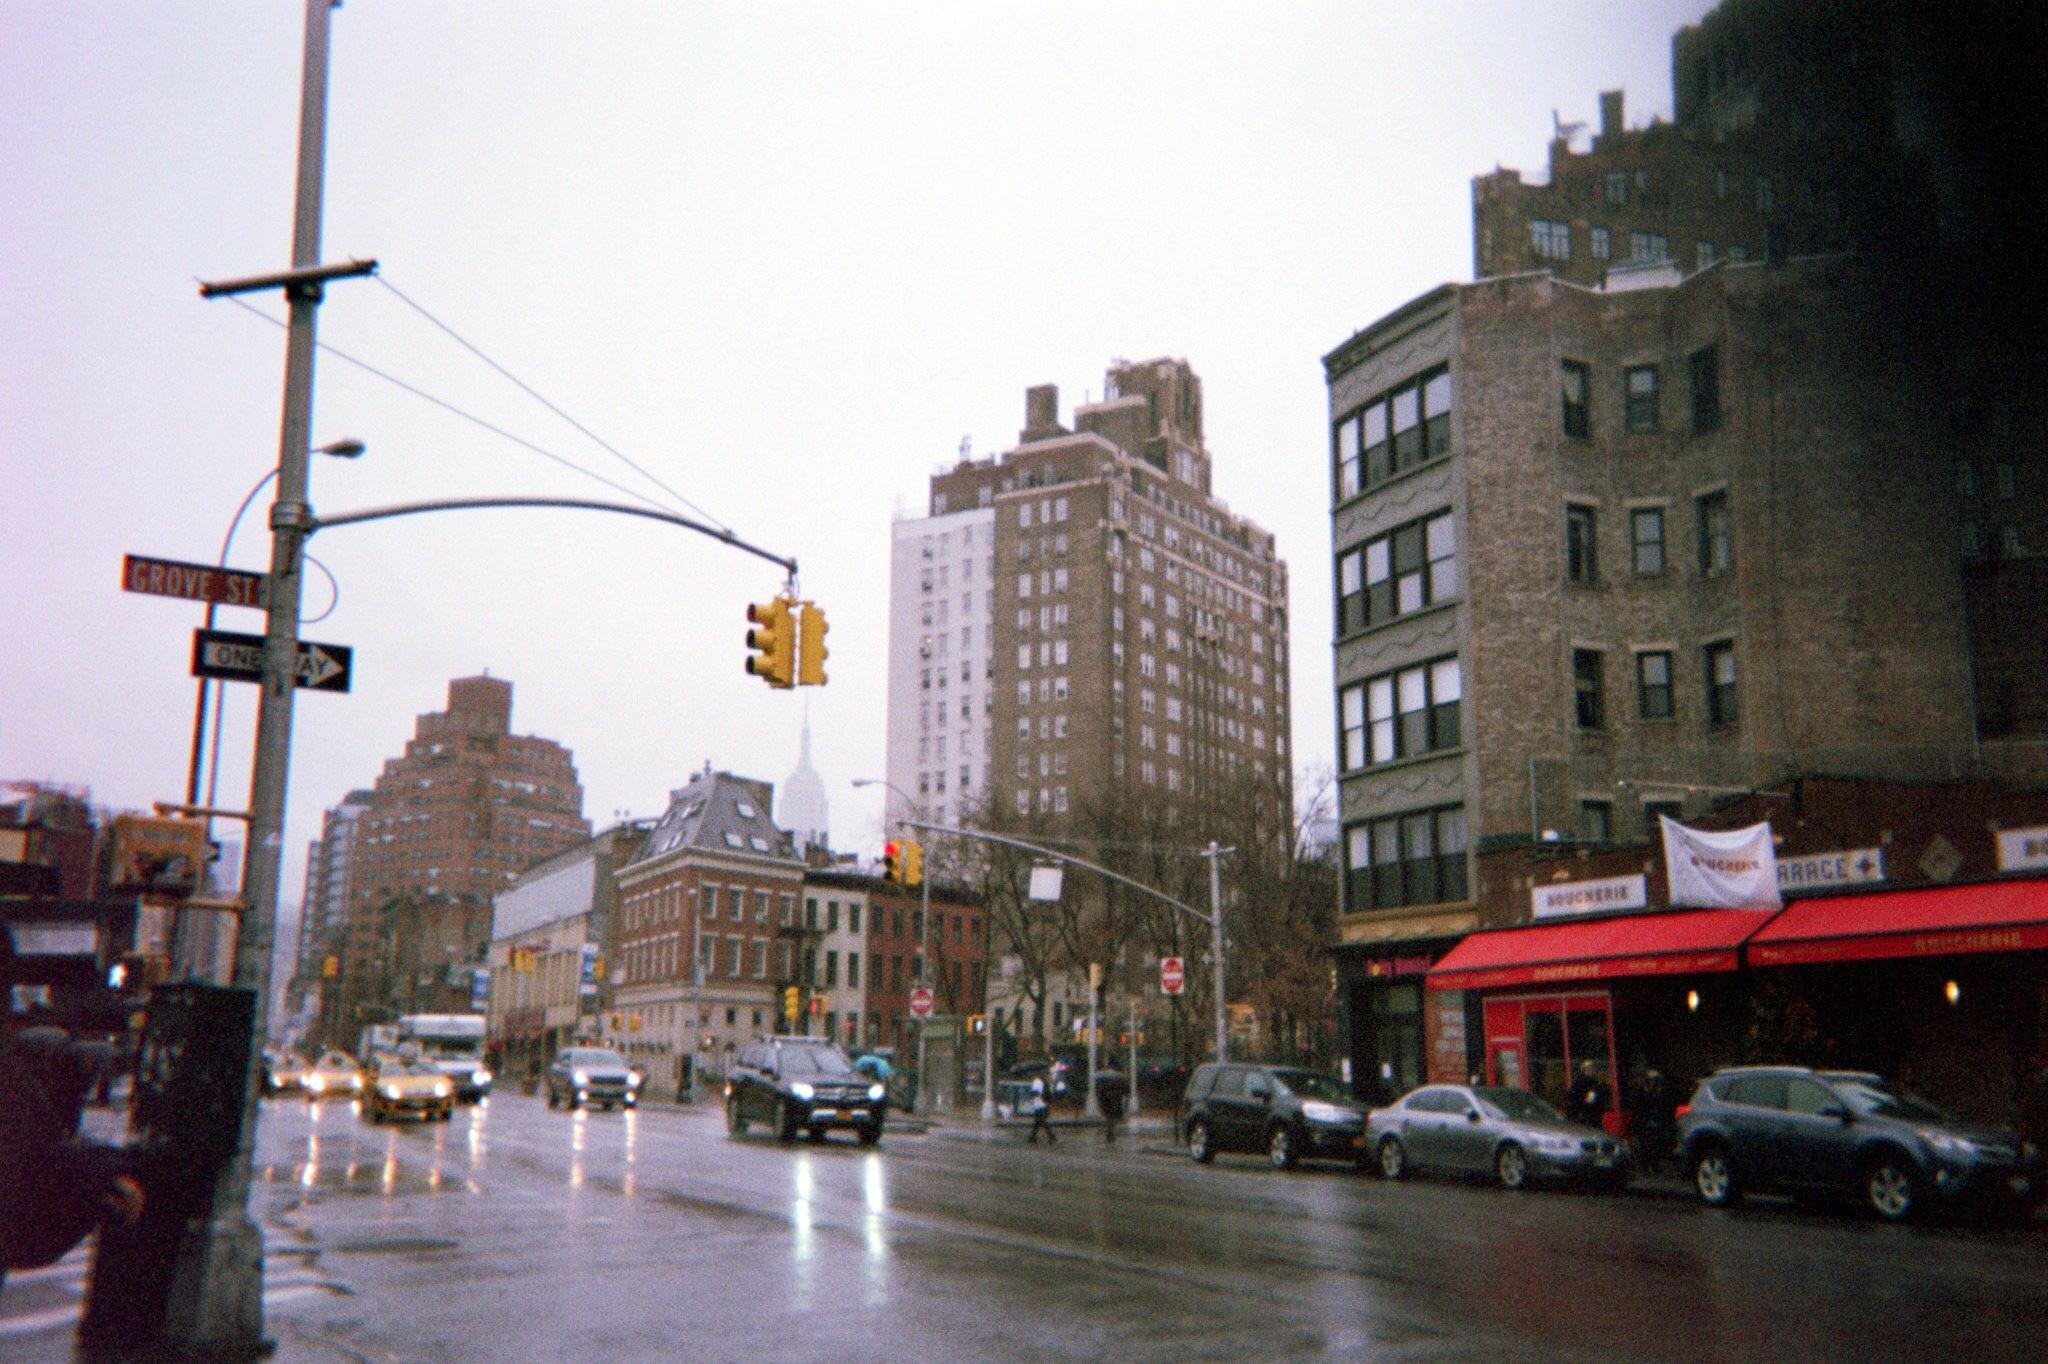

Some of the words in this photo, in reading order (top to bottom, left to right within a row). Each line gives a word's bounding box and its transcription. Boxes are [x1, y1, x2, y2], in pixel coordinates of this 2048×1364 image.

[130, 560, 213, 601] GROVE
[225, 573, 255, 605] ST
[216, 645, 259, 669] ONE
[1547, 885, 1629, 907] BOUCHERIE
